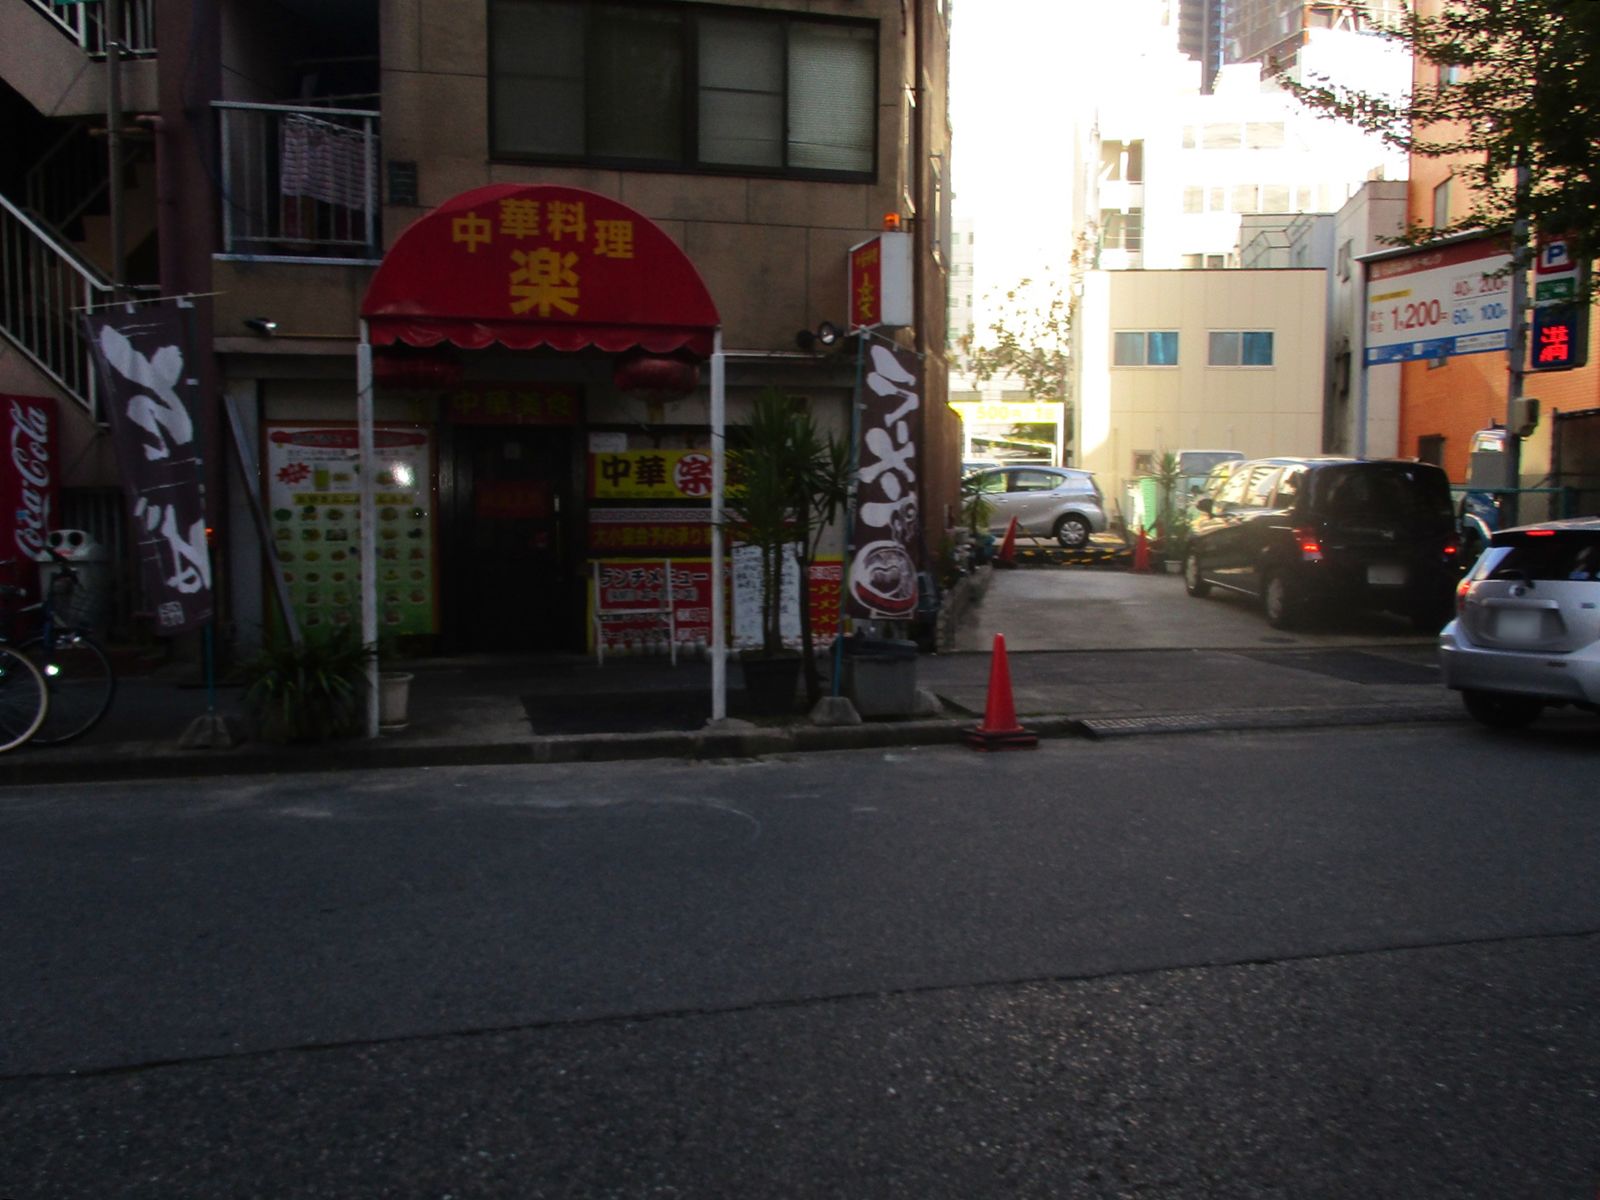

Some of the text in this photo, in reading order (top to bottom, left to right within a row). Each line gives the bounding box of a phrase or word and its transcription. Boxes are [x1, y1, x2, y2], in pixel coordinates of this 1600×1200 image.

[452, 198, 635, 259] 中華料理
[1547, 244, 1564, 264] P
[509, 247, 580, 317] 楽
